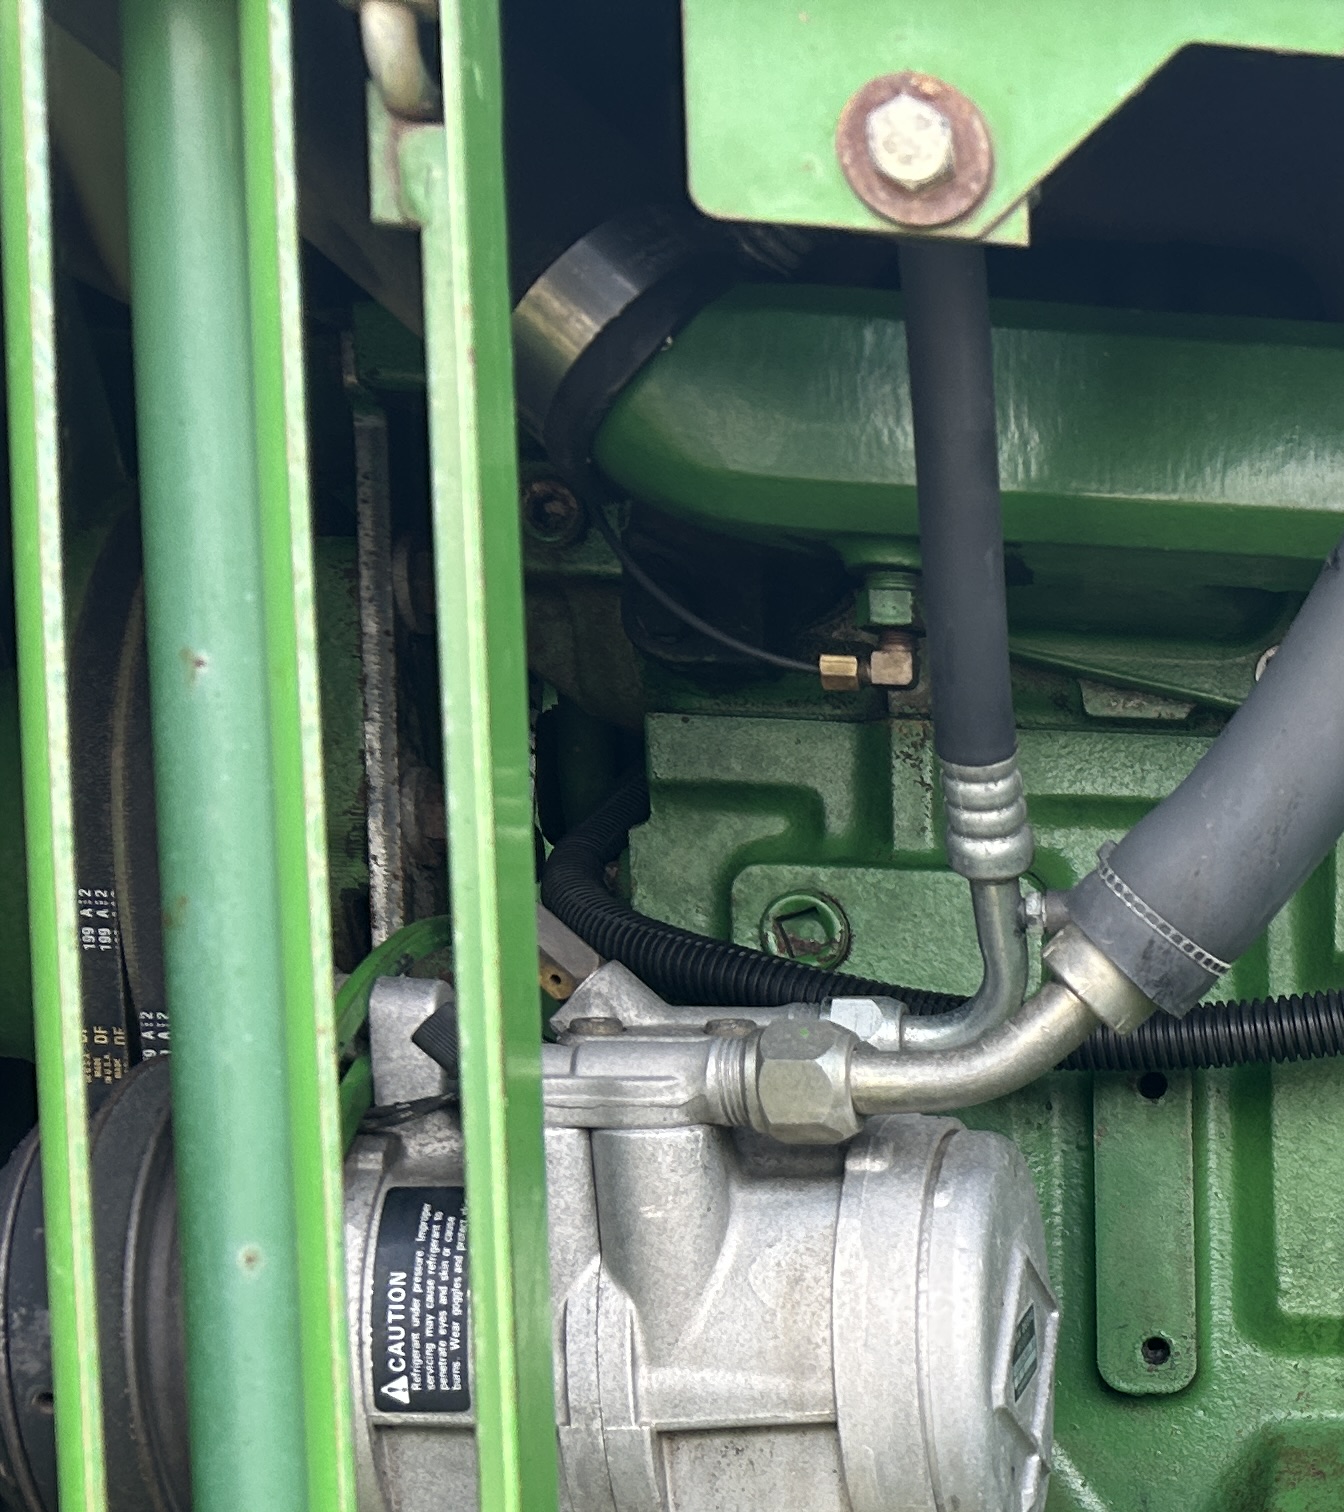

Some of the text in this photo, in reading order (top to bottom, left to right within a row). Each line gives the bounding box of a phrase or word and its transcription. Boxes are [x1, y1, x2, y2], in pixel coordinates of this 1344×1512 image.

[426, 1224, 441, 1275] refrigerant
[453, 1255, 464, 1274] and
[410, 1297, 421, 1327] under
[425, 1279, 436, 1309] cause
[438, 1216, 456, 1391] penetrate eyes and skin or cause
[451, 1276, 464, 1316] goggles
[387, 1271, 407, 1372] CAUTION
[425, 1313, 436, 1337] may
[449, 1321, 461, 1351] Wear
[410, 1332, 423, 1391] Refrigerant
[425, 1342, 437, 1390] servicing
